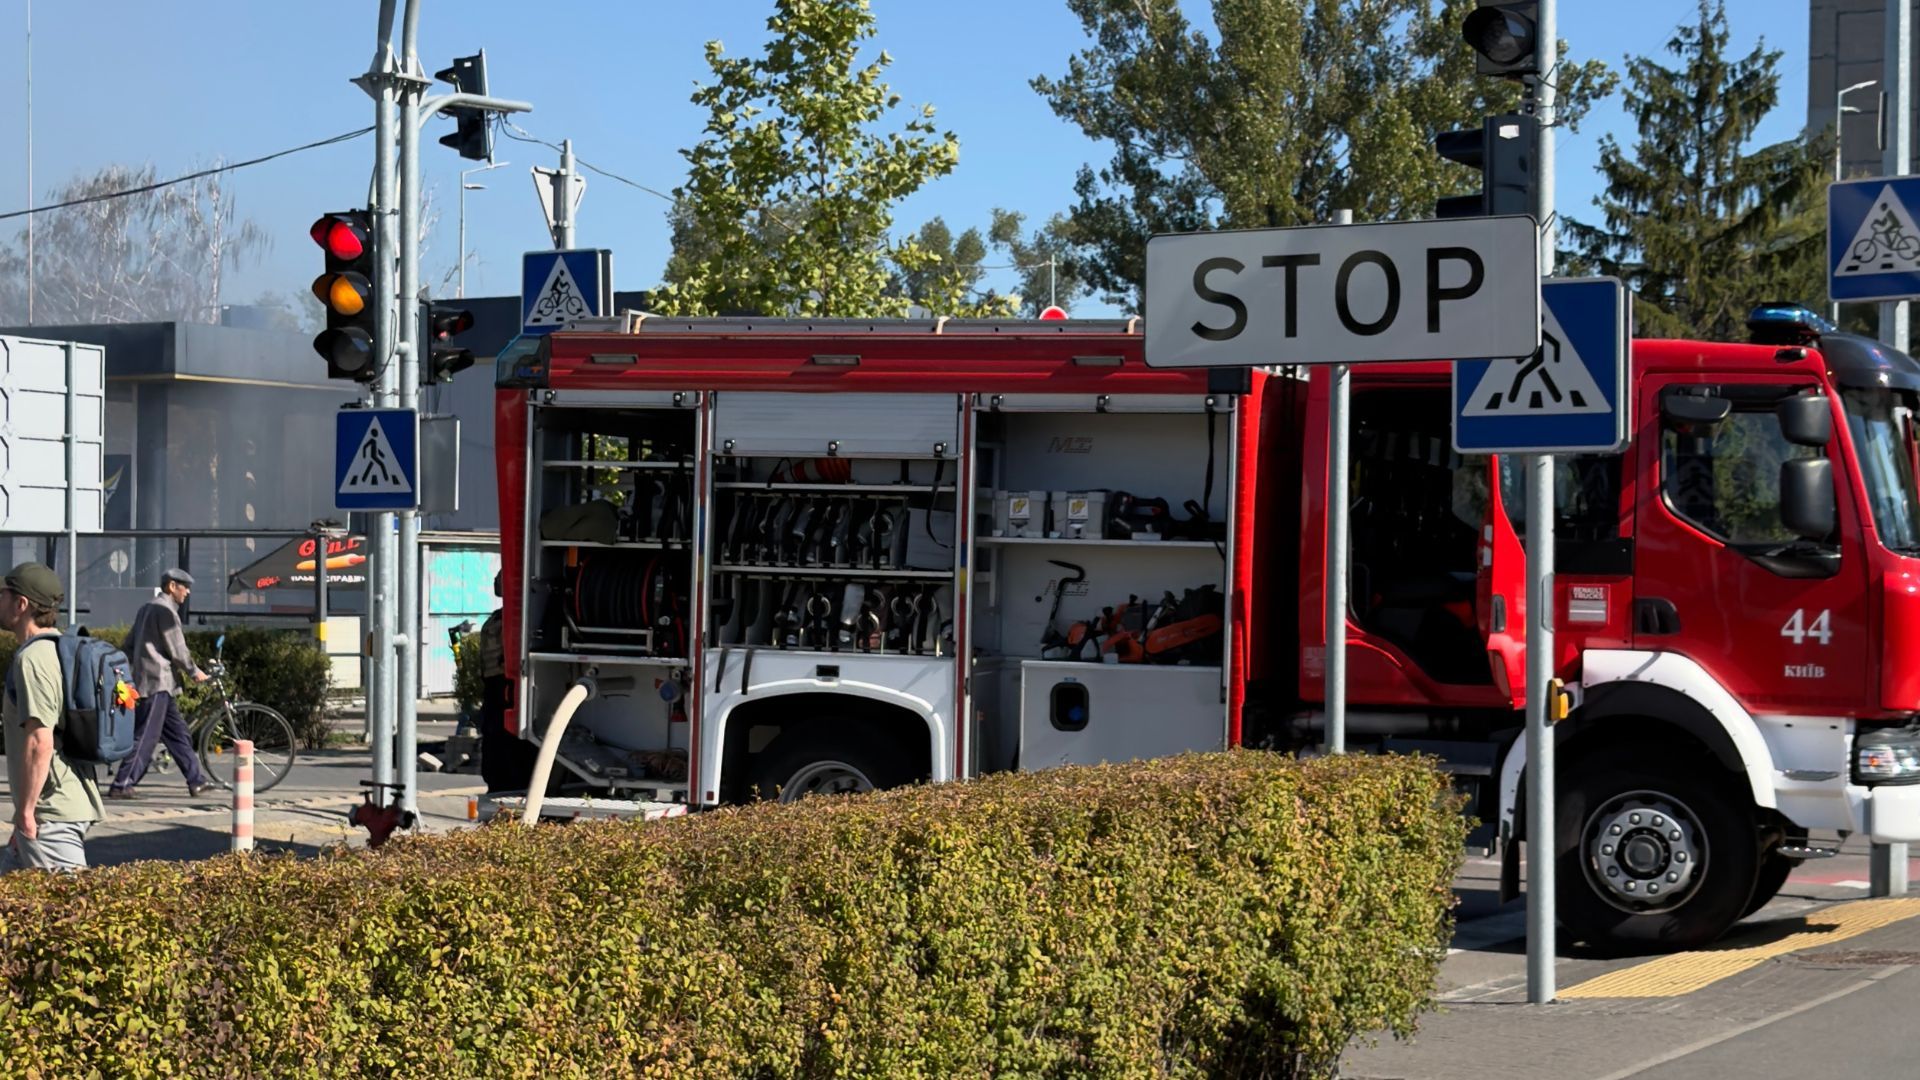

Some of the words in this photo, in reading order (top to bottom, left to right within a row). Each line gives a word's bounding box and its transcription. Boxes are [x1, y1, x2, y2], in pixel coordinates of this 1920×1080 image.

[1190, 246, 1485, 341] STOP
[299, 538, 360, 556] GILL
[1781, 608, 1833, 645] 44
